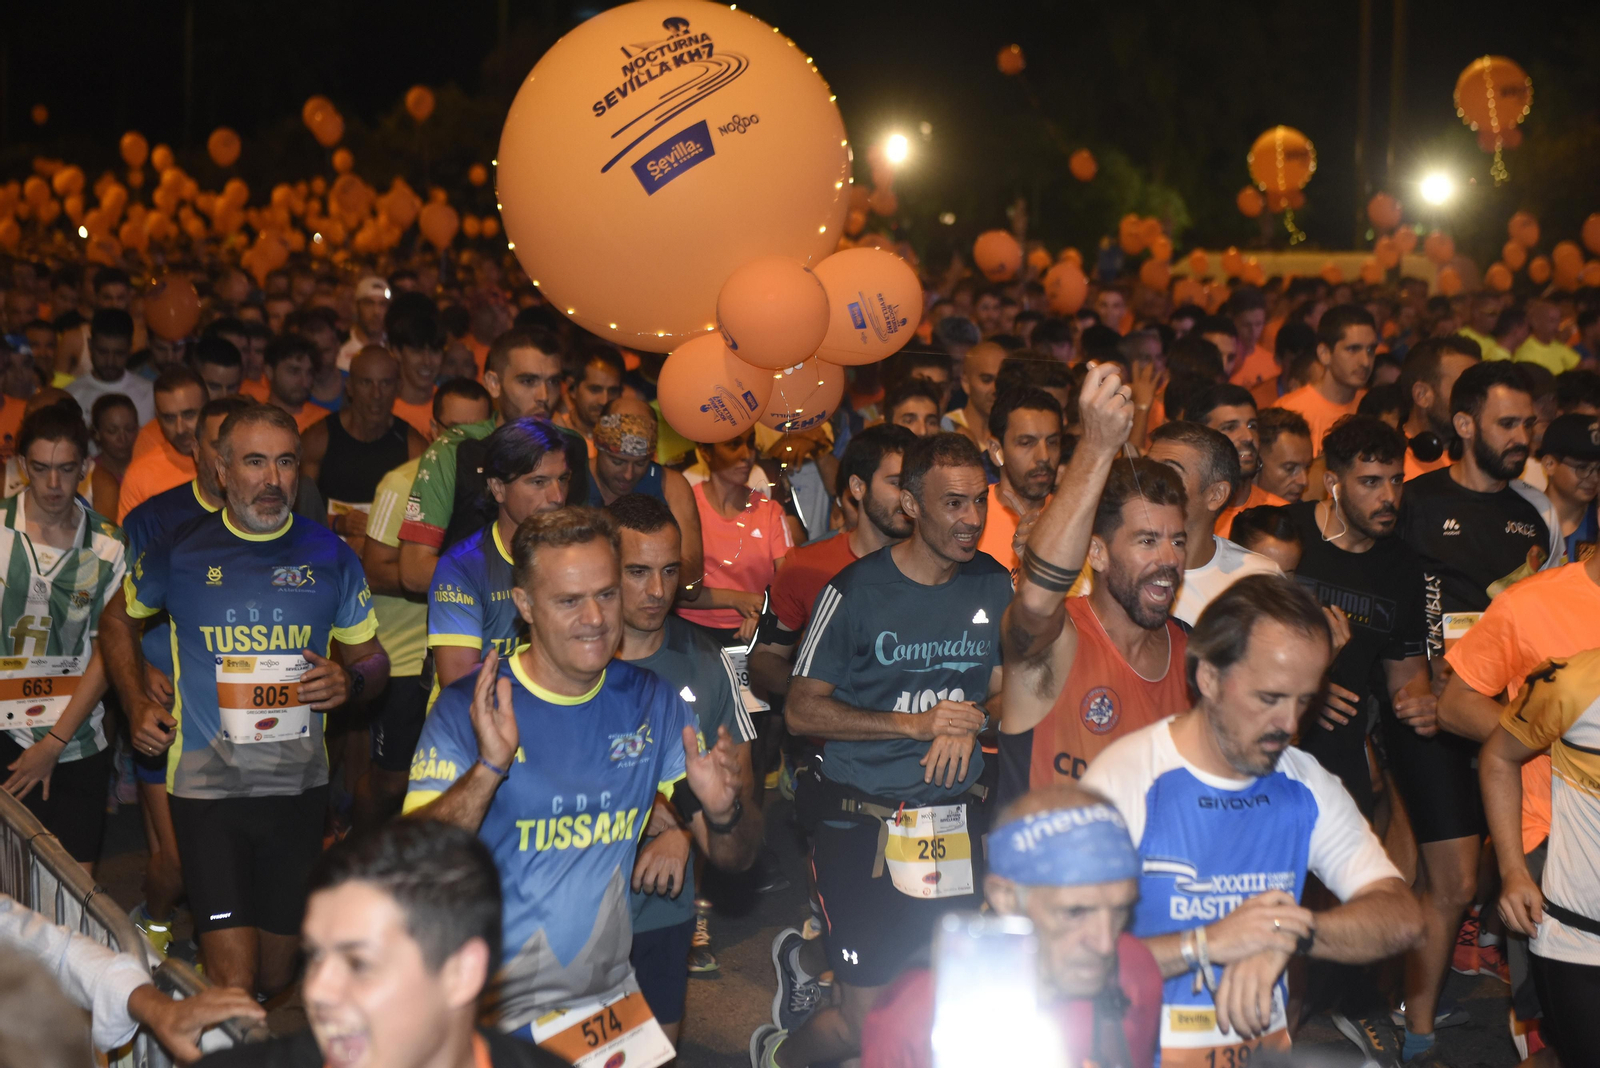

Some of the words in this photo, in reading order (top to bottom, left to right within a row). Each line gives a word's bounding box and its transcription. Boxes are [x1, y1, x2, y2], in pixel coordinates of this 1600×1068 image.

[621, 32, 712, 77] NOCTURNA
[592, 61, 673, 117] SEVILLA
[877, 293, 890, 321] SEVILLA
[721, 406, 738, 427] SEVILLA
[434, 591, 475, 606] TUSSAM
[199, 624, 312, 653] TUSSAM
[875, 629, 991, 668] Compadres
[22, 678, 53, 697] 663
[252, 685, 289, 707] 805
[1198, 793, 1271, 810] GIVOVA
[515, 806, 639, 852] TUSSAM
[917, 837, 947, 860] 285
[581, 1007, 623, 1047] 574
